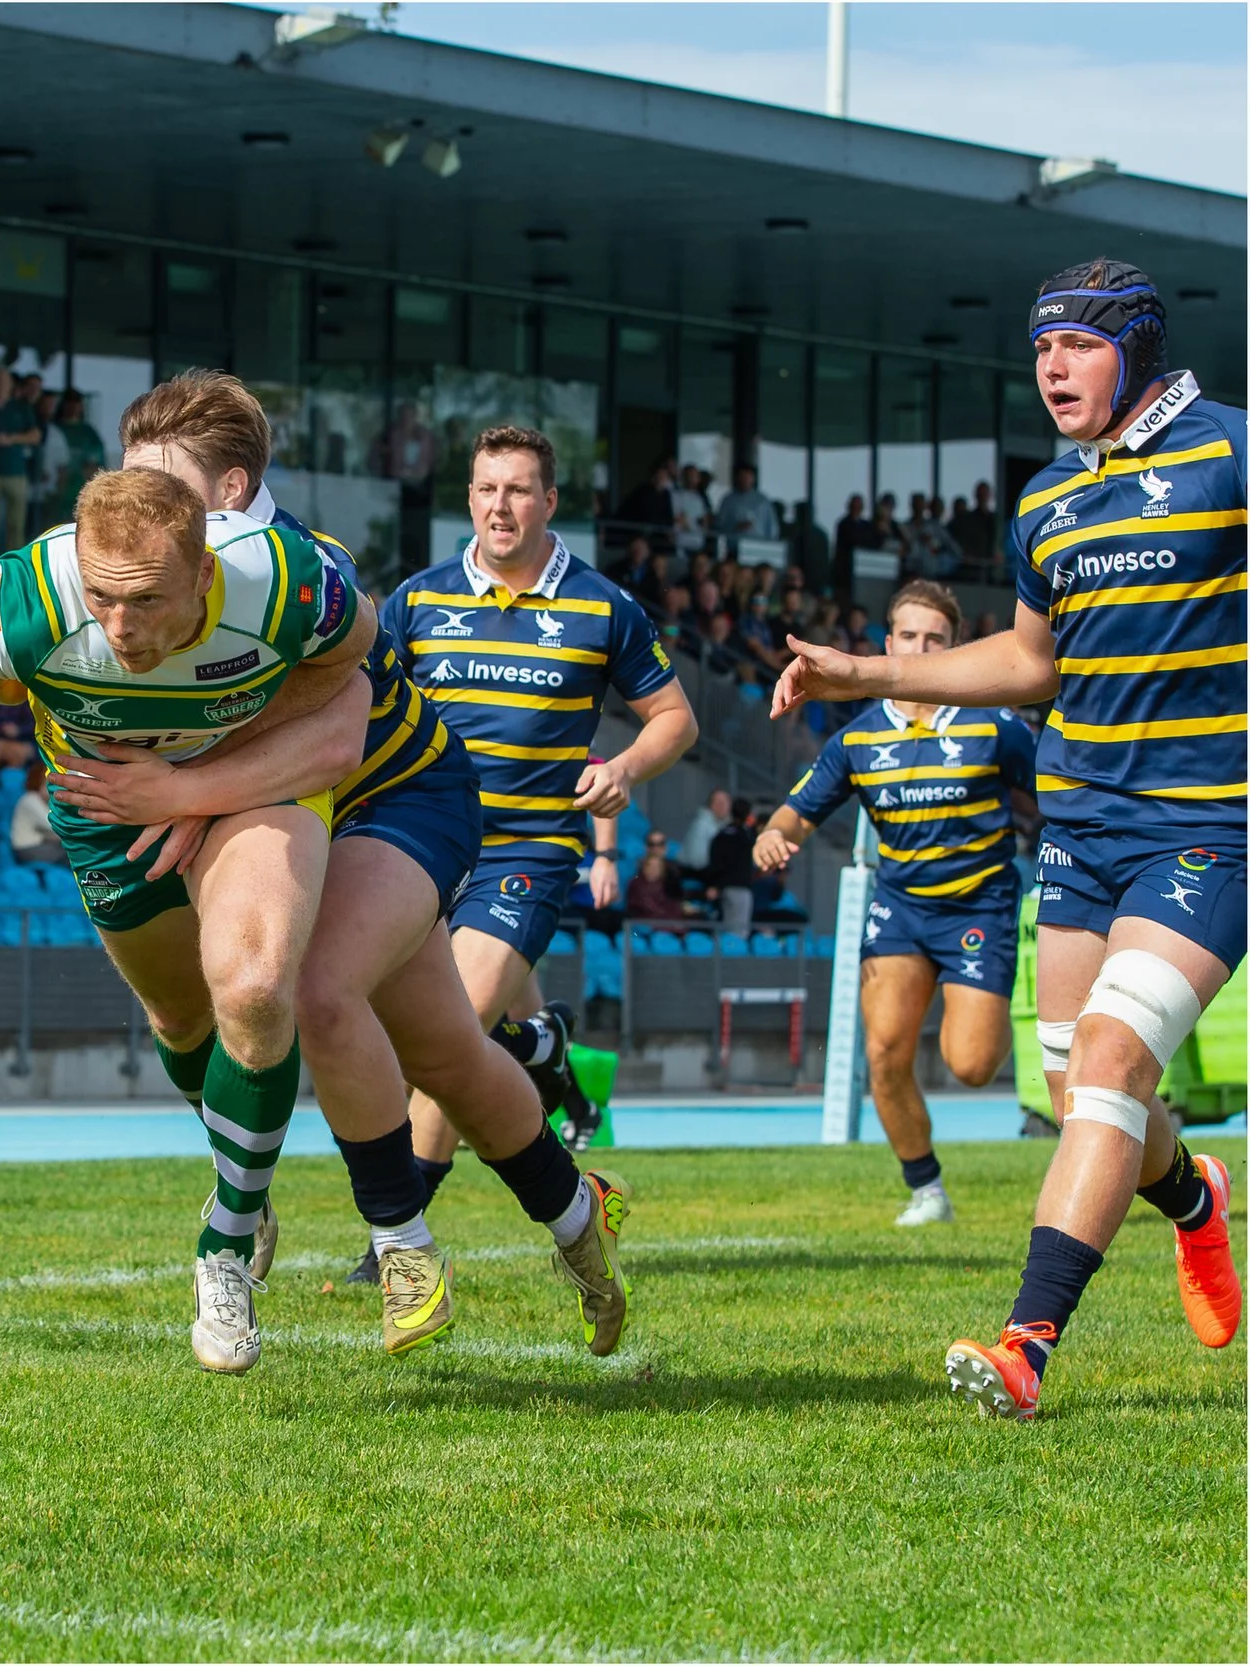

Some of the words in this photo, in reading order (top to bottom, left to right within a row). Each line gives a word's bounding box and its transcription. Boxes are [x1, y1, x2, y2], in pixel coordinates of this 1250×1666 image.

[1141, 509, 1170, 518] HAWKS
[1142, 503, 1170, 512] HENLEY
[1077, 549, 1177, 578] Invesco
[431, 628, 474, 637] GILBERT
[199, 654, 256, 675] LEAPFROG
[467, 659, 564, 687] Invesco
[210, 698, 262, 719] RAIDERS
[899, 785, 968, 803] Invesco
[235, 1332, 261, 1358] F50
